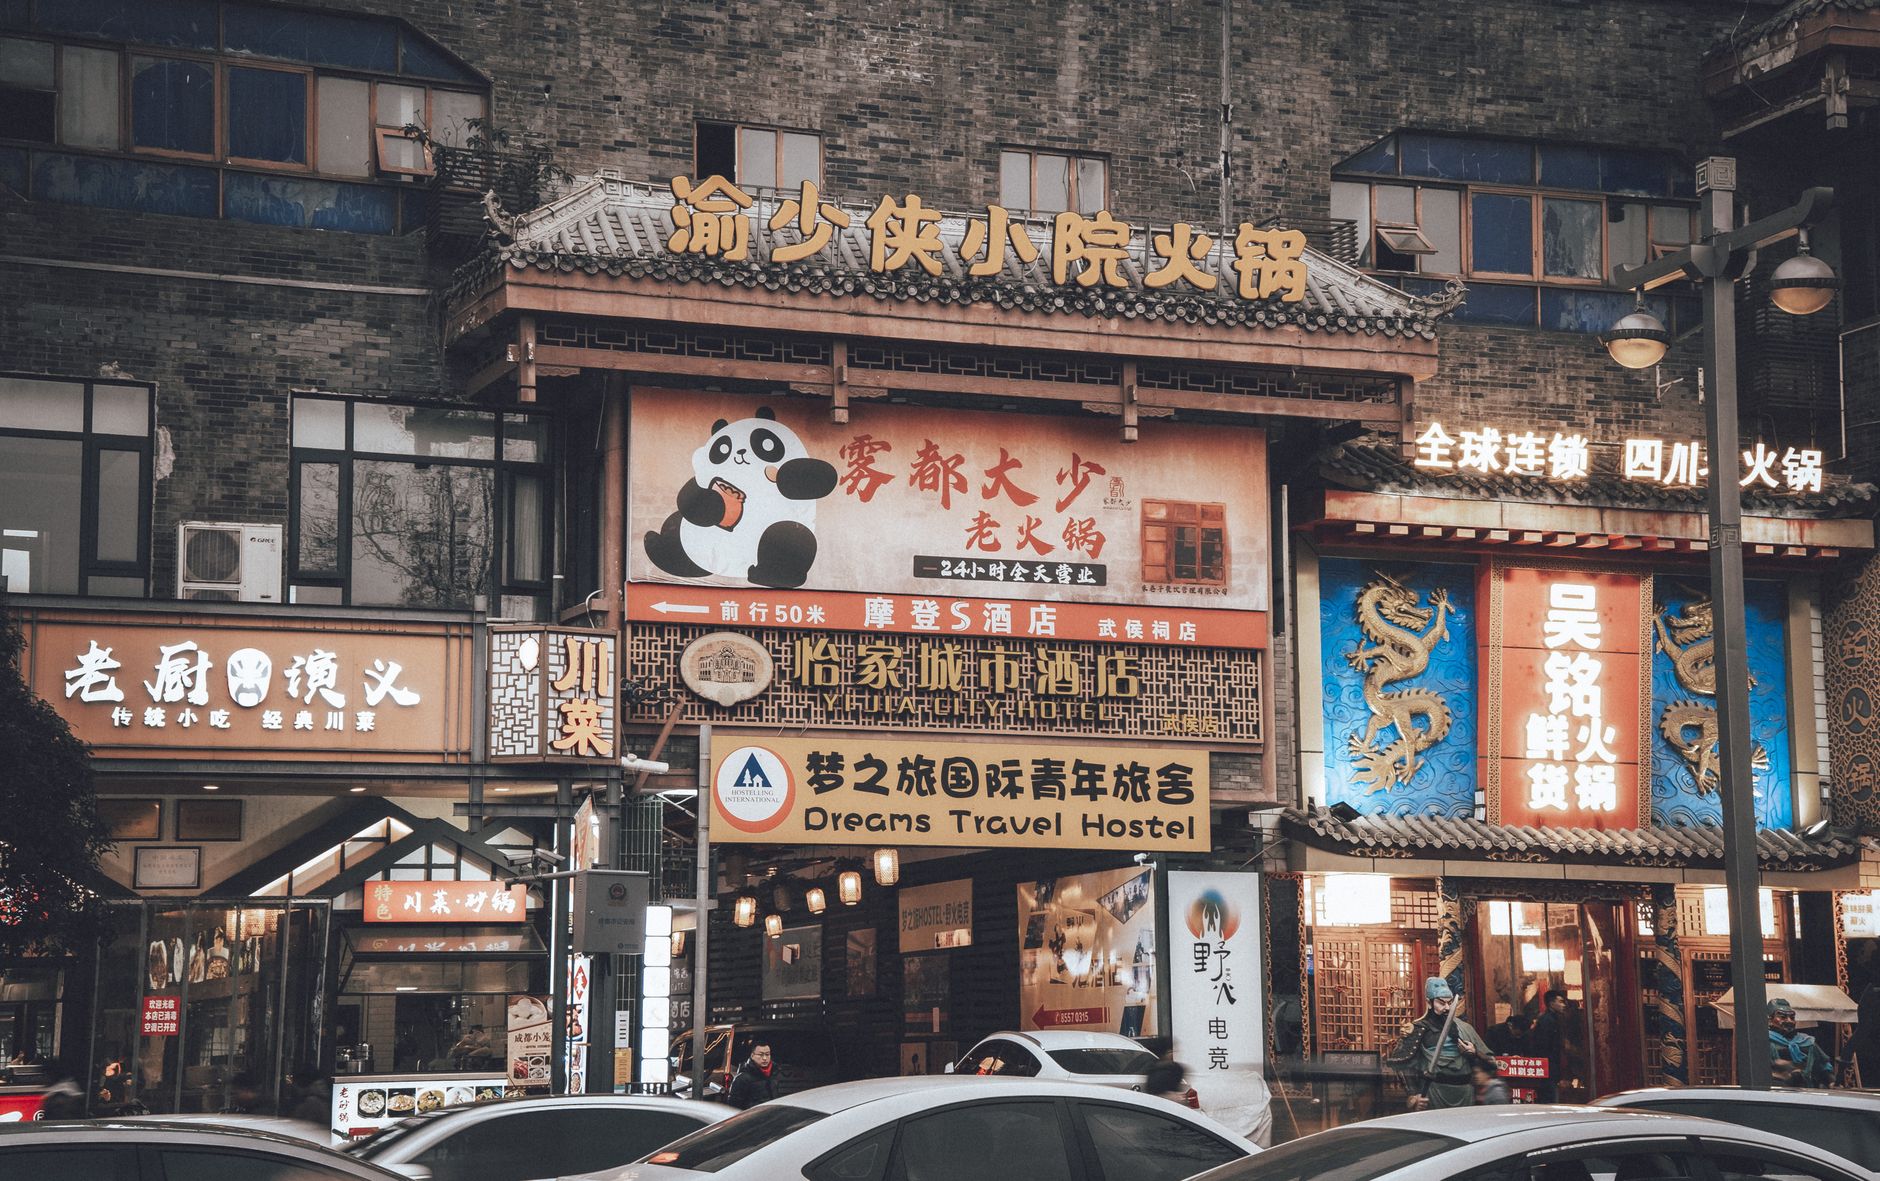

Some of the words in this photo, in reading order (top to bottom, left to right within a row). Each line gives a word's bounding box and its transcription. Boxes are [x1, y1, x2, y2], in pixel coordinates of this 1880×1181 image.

[668, 174, 1307, 302] 渝少侠小院火锅
[838, 433, 1106, 511] 雾都大少
[1413, 422, 1588, 481] 全球连锁
[1624, 438, 1823, 493] 四川火锅
[964, 510, 1106, 560] 老火锅
[940, 559, 1097, 585] 24小时全天营业
[719, 601, 826, 624] 前行50米
[864, 597, 1057, 636] 摩登S酒店
[1098, 618, 1198, 642] 武侯祠店
[793, 637, 1139, 699] 怡家城市酒店
[1543, 583, 1602, 717] 吴铭
[551, 636, 612, 756] 川菜
[933, 698, 1000, 716] CITY
[1018, 700, 1112, 721] HOTEL
[111, 706, 231, 729] 传统小吃
[262, 709, 376, 732] 经典川菜
[805, 750, 1194, 805] 梦之旅国际青年旅舍
[804, 806, 931, 835] Dreams
[950, 809, 1062, 837] Travel
[1081, 811, 1194, 840] Hostel
[374, 884, 393, 920] 特色
[144, 1022, 177, 1032] 空调已开放
[145, 1011, 177, 1020] 本店已消毒
[149, 1000, 175, 1009] 欢迎光临
